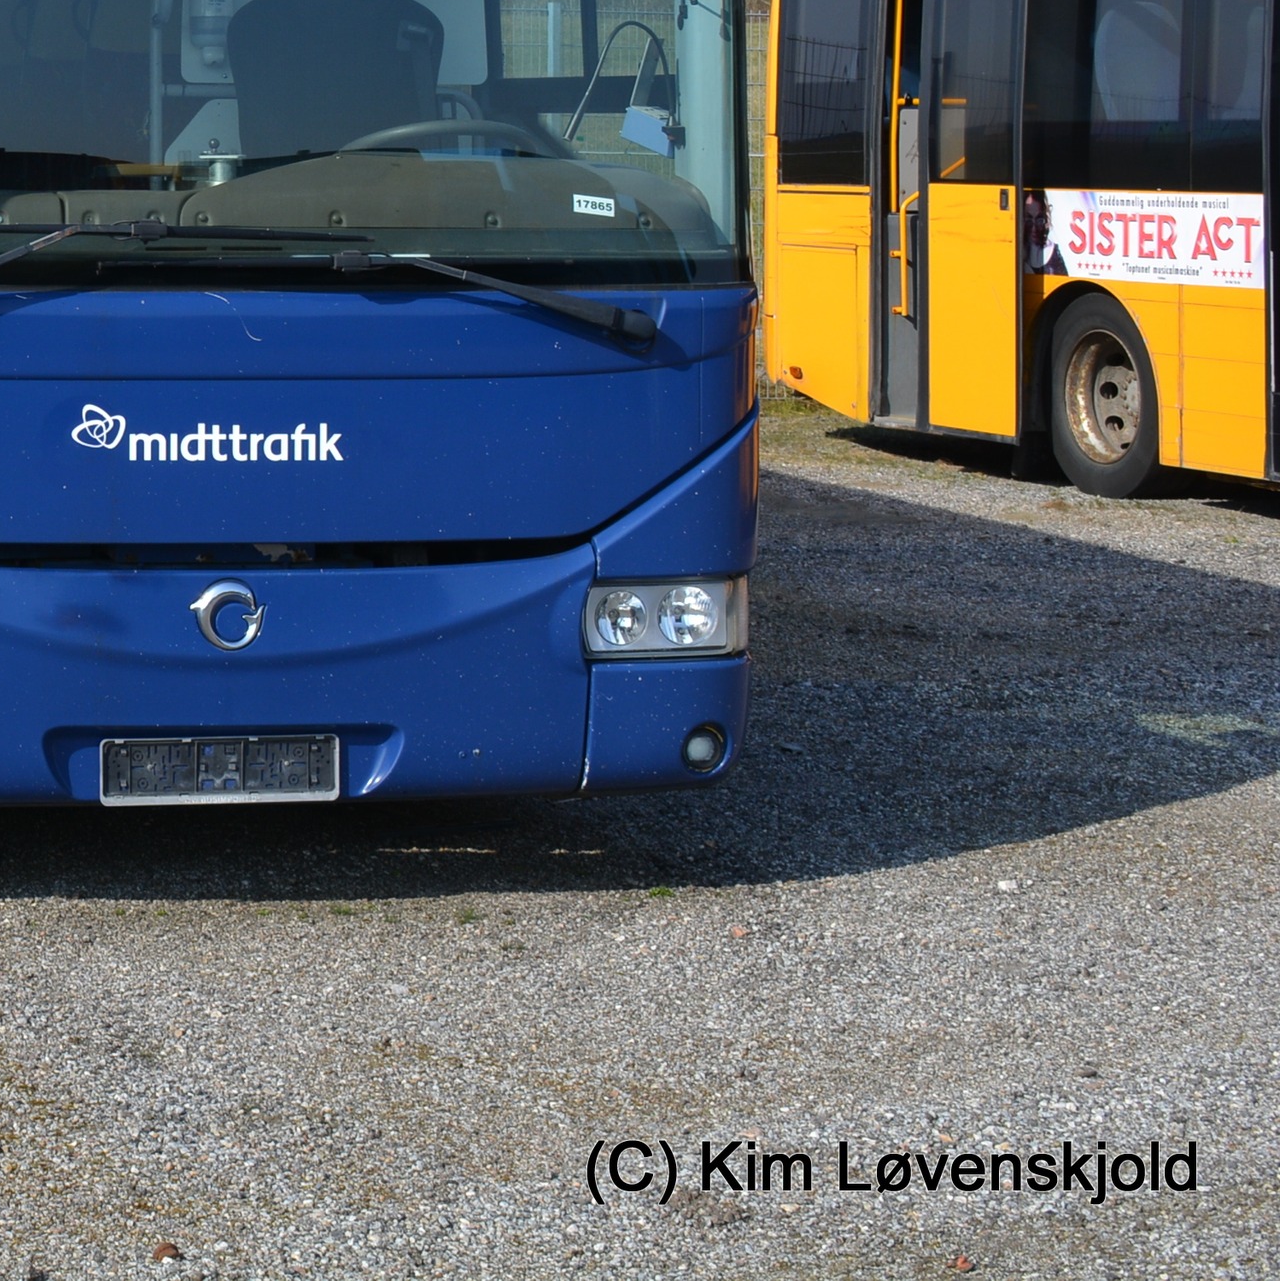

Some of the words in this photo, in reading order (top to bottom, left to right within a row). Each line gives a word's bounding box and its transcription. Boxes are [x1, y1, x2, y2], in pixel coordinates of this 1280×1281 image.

[575, 199, 613, 212] 17865
[1098, 195, 1145, 209] Guddommelig
[1147, 196, 1199, 209] underholdende
[1201, 198, 1230, 209] musical
[1068, 209, 1178, 260] SISTER
[1191, 213, 1262, 264] ACT
[128, 422, 345, 462] midttrafik
